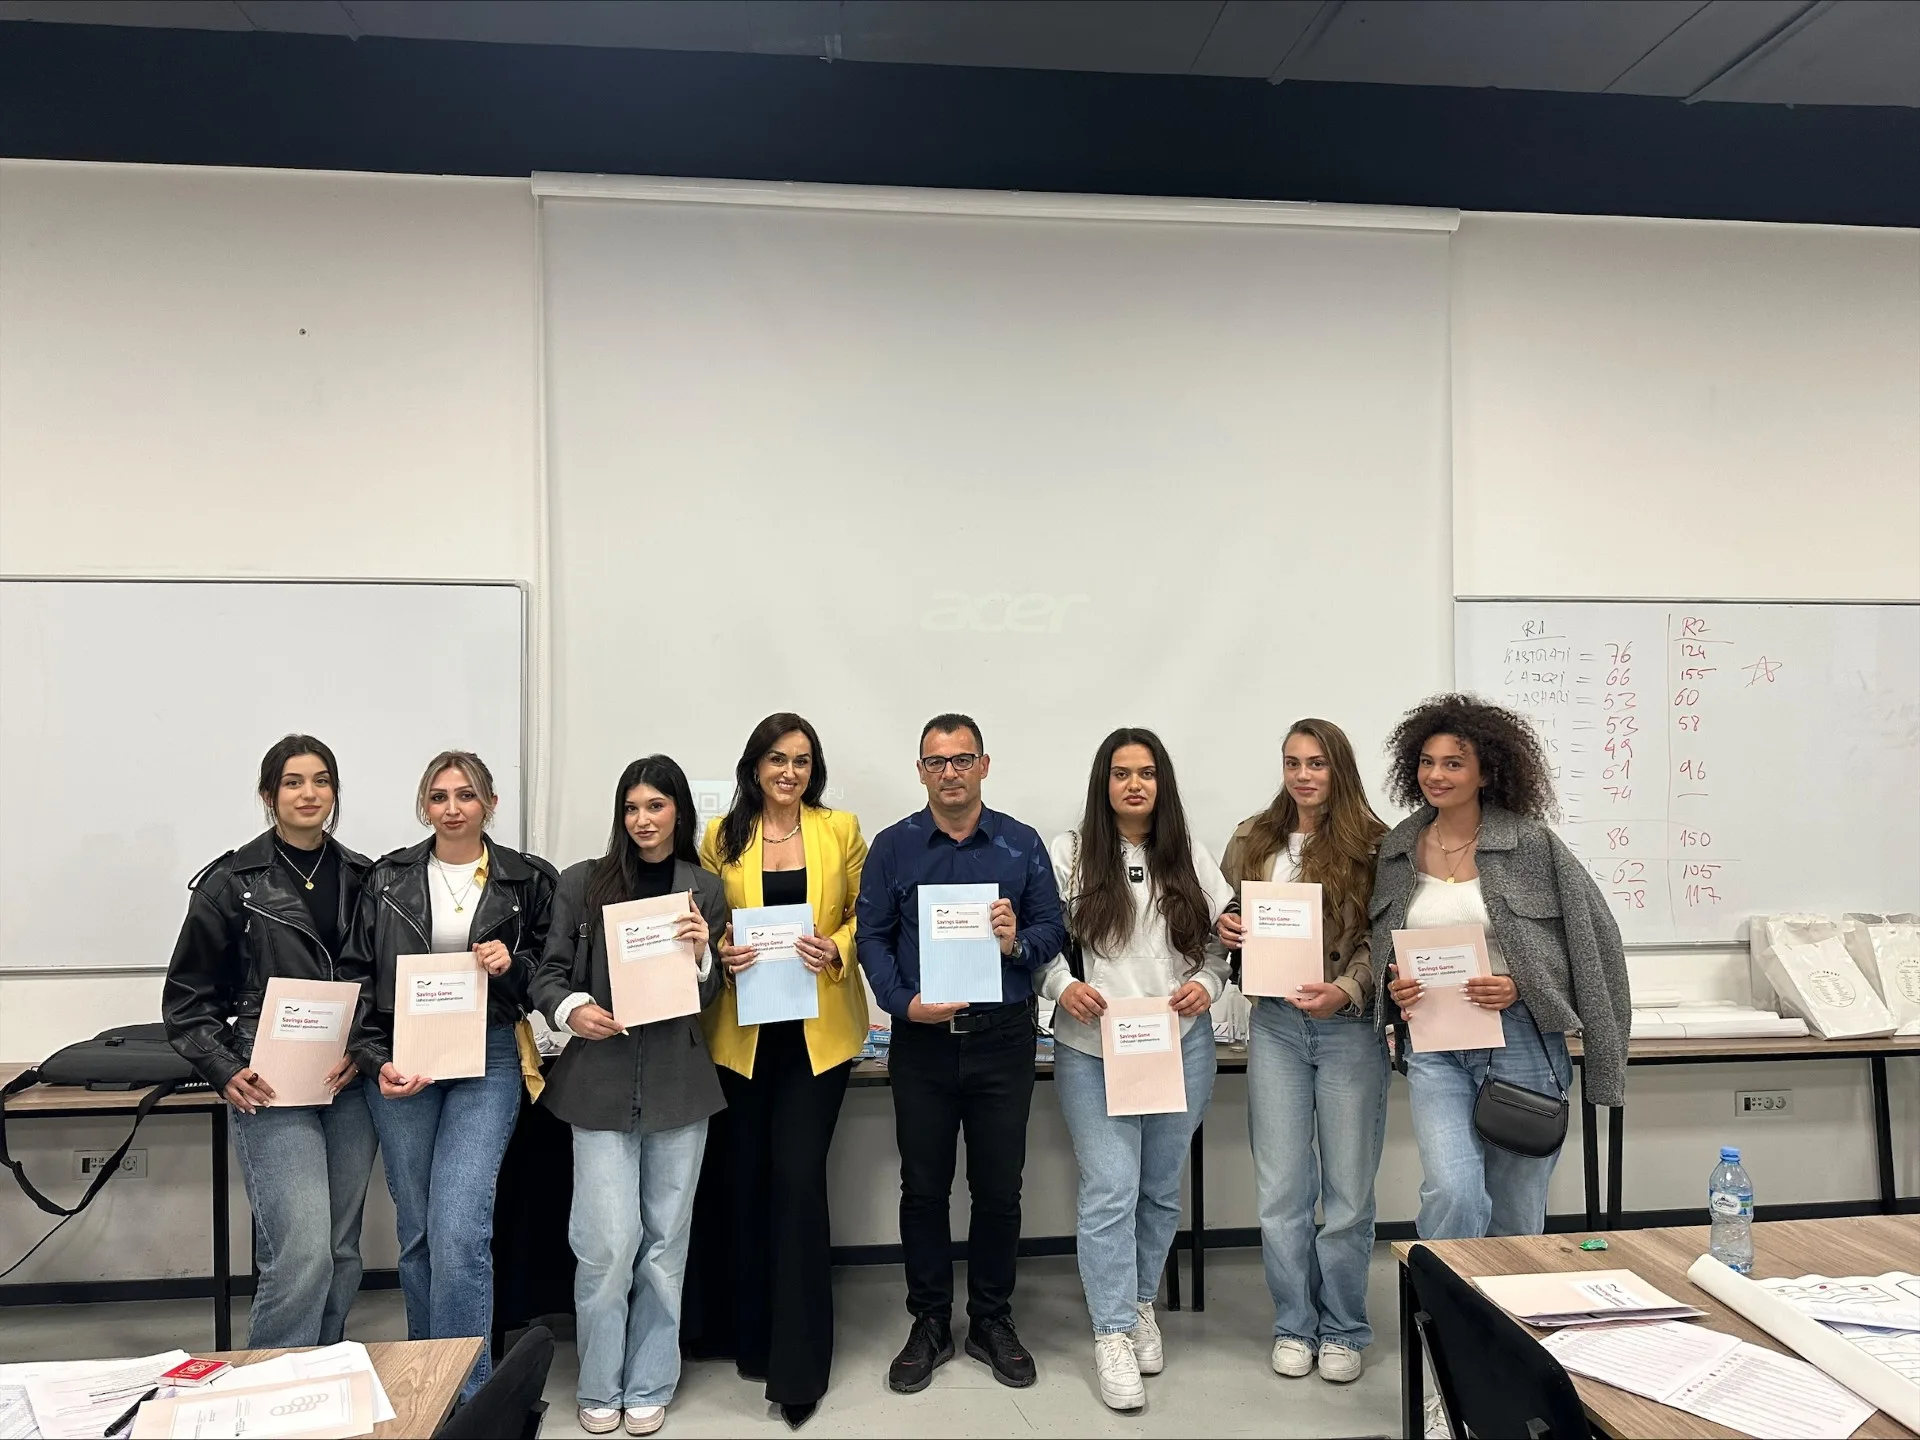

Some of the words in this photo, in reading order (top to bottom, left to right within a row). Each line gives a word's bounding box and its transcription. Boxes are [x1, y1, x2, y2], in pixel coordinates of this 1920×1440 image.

[919, 589, 1091, 633] acer
[1521, 619, 1545, 637] R1
[1681, 616, 1711, 636] R2
[1604, 640, 1633, 665] 76
[1681, 643, 1707, 660] 124
[1605, 667, 1631, 686] 66
[1680, 667, 1717, 681] 155
[1674, 687, 1699, 706] 60
[1606, 715, 1639, 737] 53
[1678, 714, 1700, 732] 58
[1604, 737, 1634, 760] 49
[1679, 759, 1706, 780] 96
[1606, 826, 1630, 850] 86
[1680, 829, 1711, 848] 150
[1682, 863, 1721, 880] 105
[1612, 889, 1646, 910] 78
[1685, 884, 1721, 907] 117
